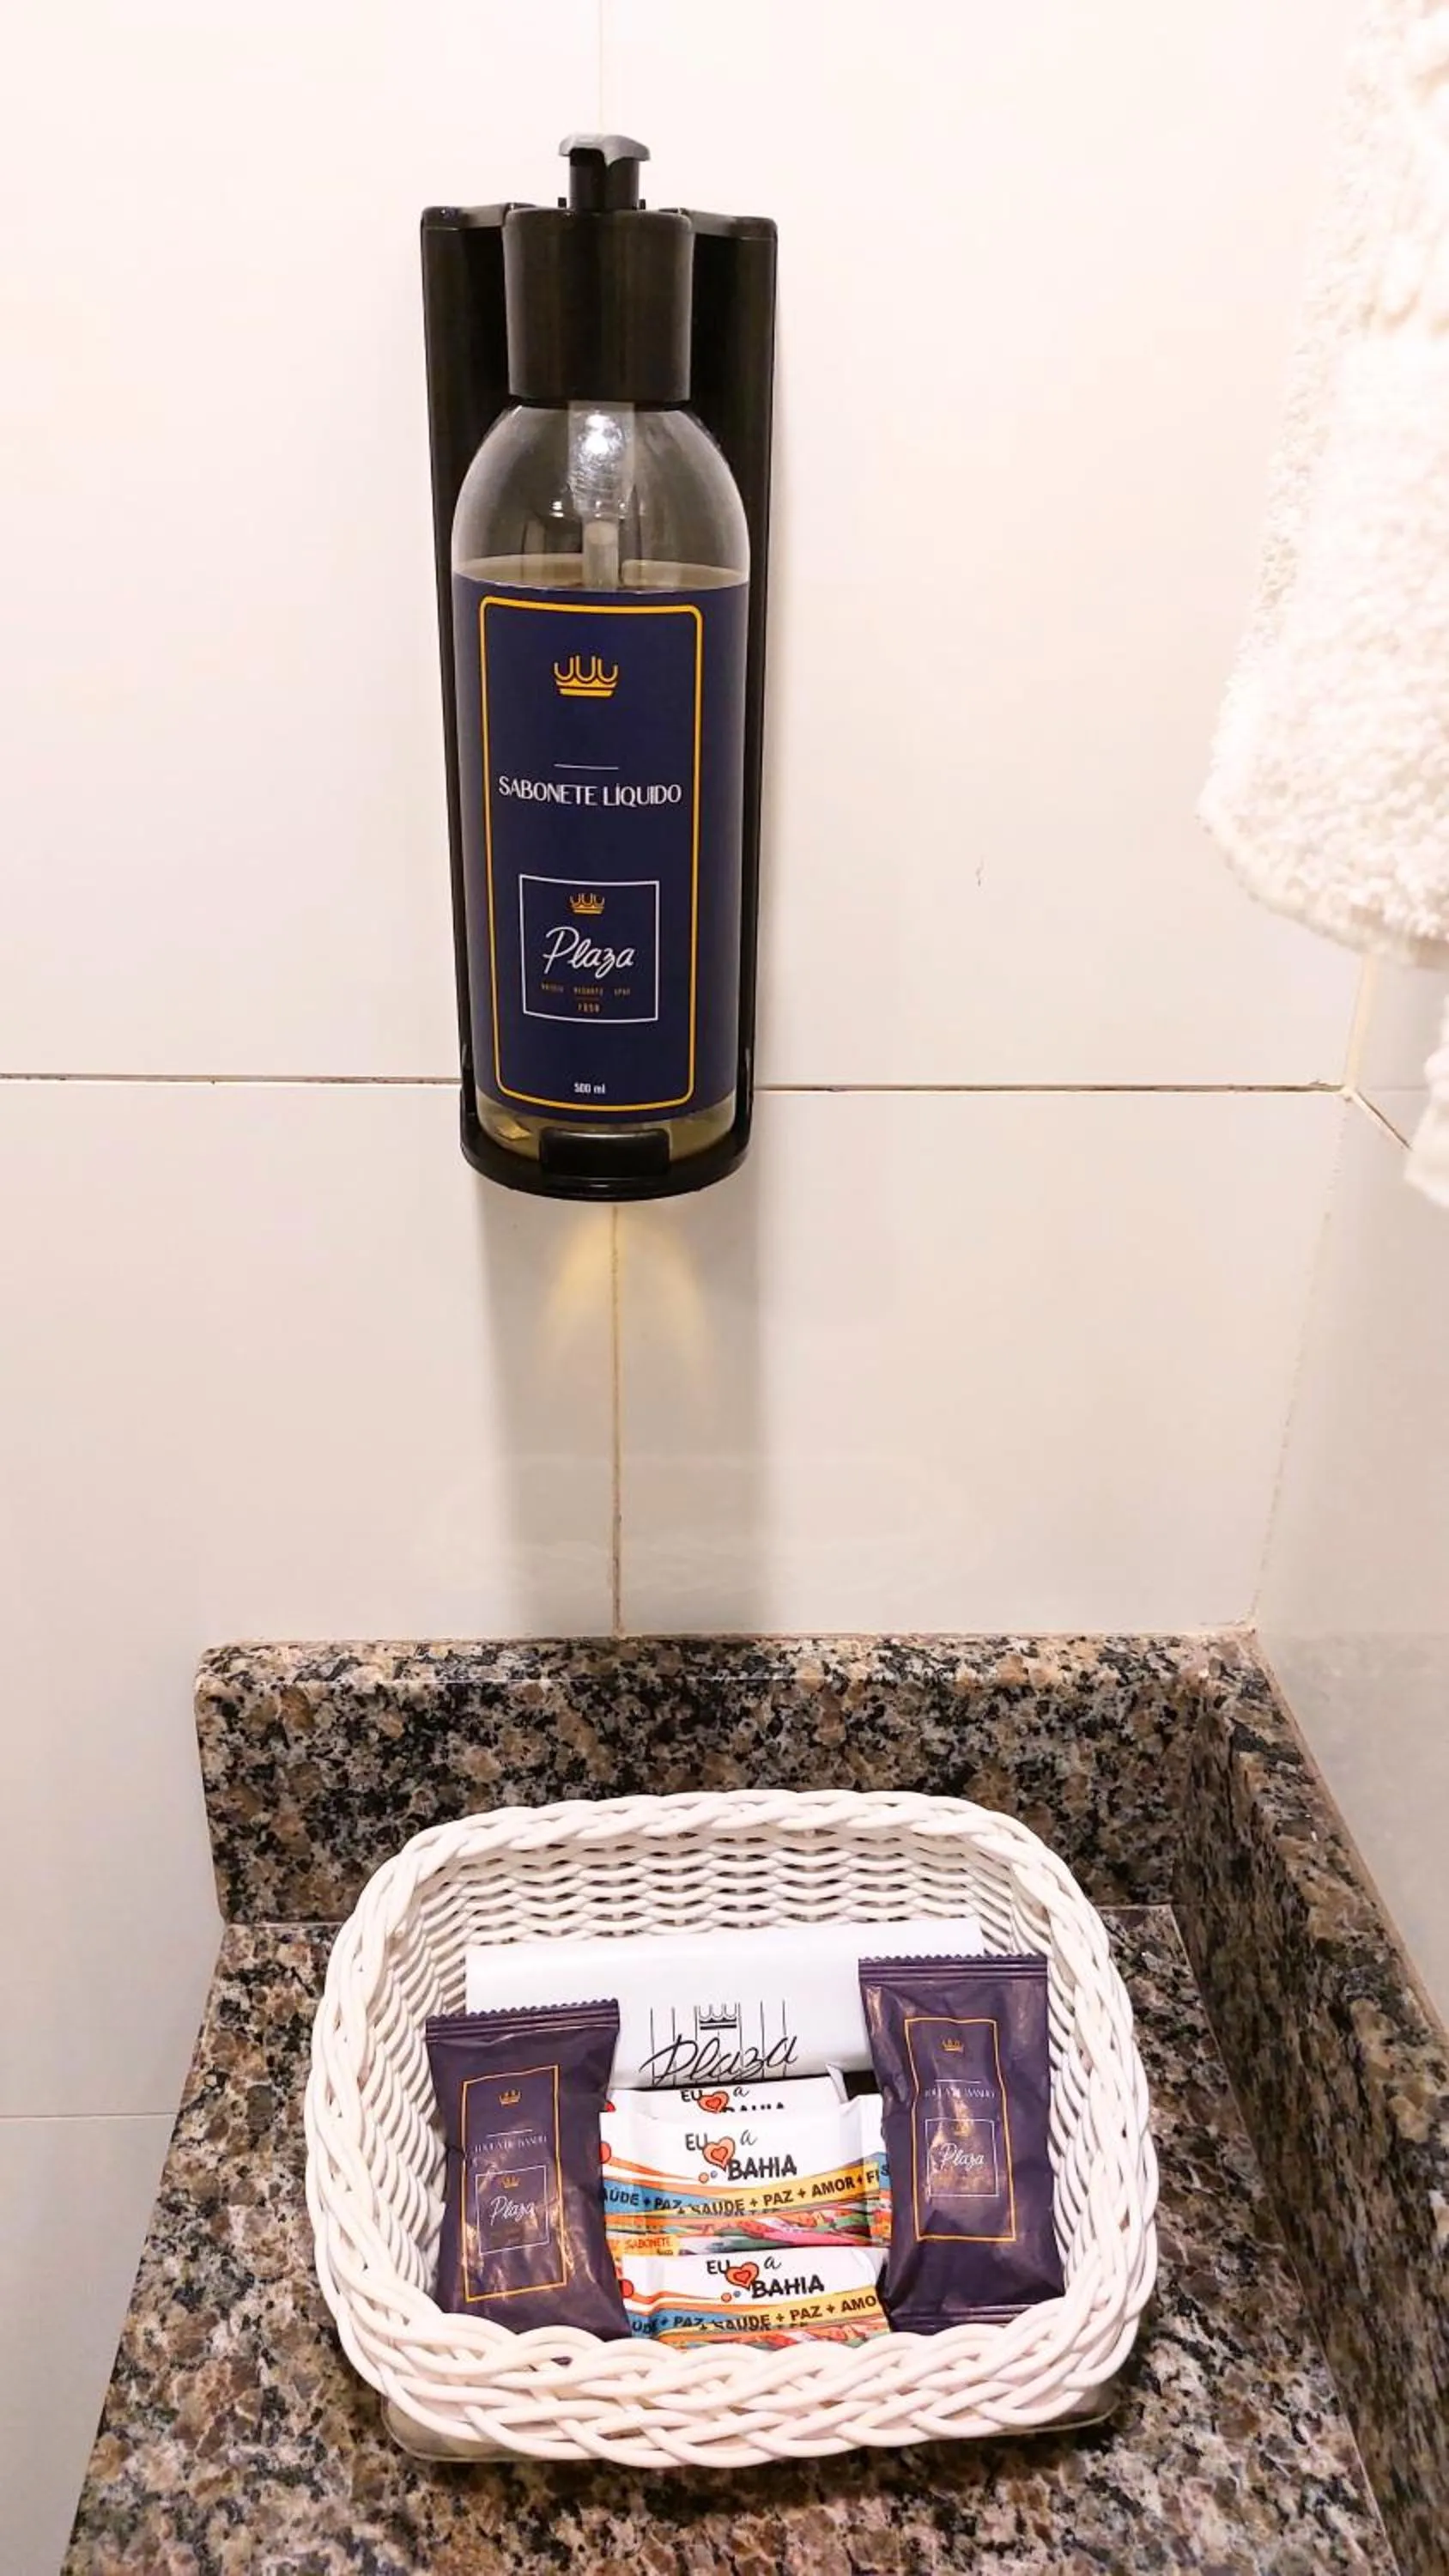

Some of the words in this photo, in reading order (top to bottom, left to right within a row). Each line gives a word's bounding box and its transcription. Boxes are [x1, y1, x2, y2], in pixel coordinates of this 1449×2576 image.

[498, 775, 598, 806] SABONETE
[543, 926, 635, 979] Plaza
[573, 1082, 591, 1093] 500
[593, 1083, 606, 1094] ml
[638, 2033, 798, 2087] Plaza
[680, 2089, 703, 2103] EU
[732, 2086, 749, 2098] a
[685, 2132, 708, 2151] EU
[740, 2129, 758, 2146] a
[727, 2154, 797, 2181] BAHIA
[939, 2142, 985, 2172] Plaza
[762, 2190, 794, 2207] PAZ
[811, 2176, 855, 2198] AMOR
[489, 2196, 537, 2227] Plaza
[706, 2259, 730, 2275] EU
[763, 2256, 781, 2269] a
[751, 2274, 825, 2300] BAHIA
[789, 2306, 823, 2321] PAZ
[841, 2295, 876, 2312] AMO
